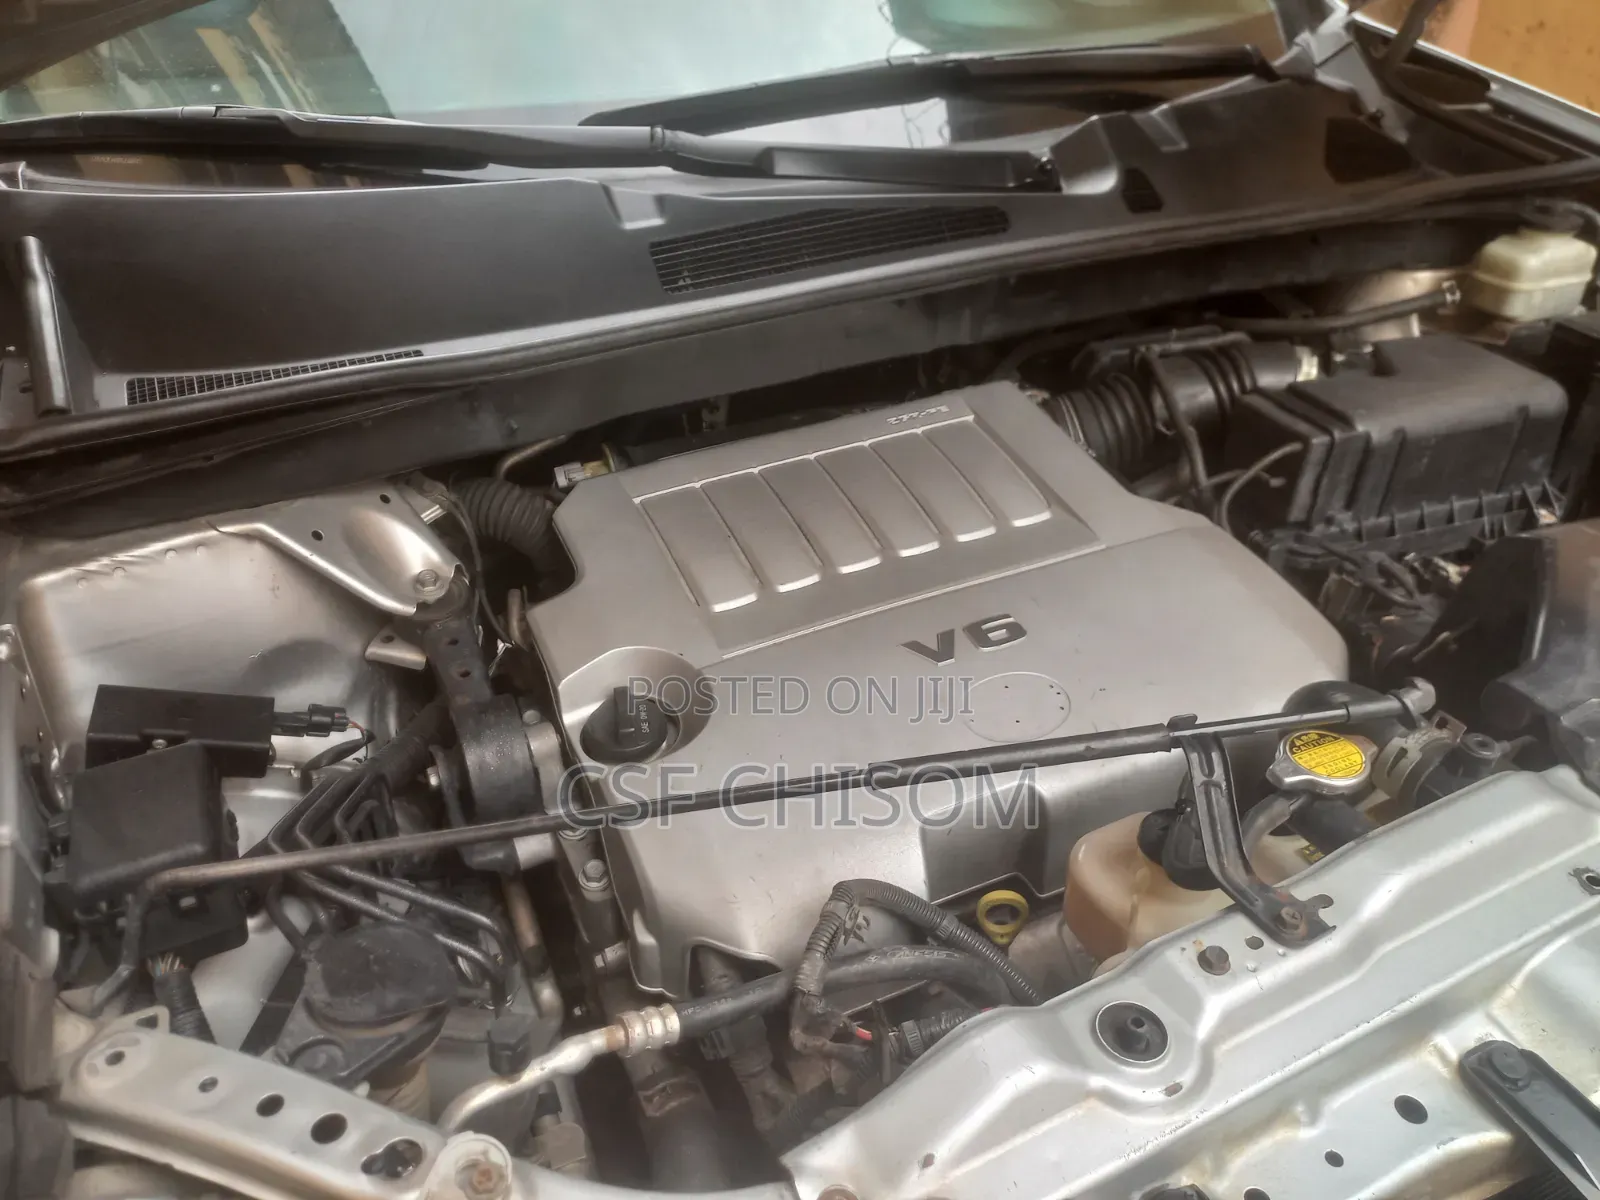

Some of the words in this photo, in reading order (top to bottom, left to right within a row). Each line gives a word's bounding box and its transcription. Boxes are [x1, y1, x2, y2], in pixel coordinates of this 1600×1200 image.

[899, 613, 1028, 667] V6
[641, 721, 650, 734] SAE
[1292, 735, 1336, 754] CAUTION
